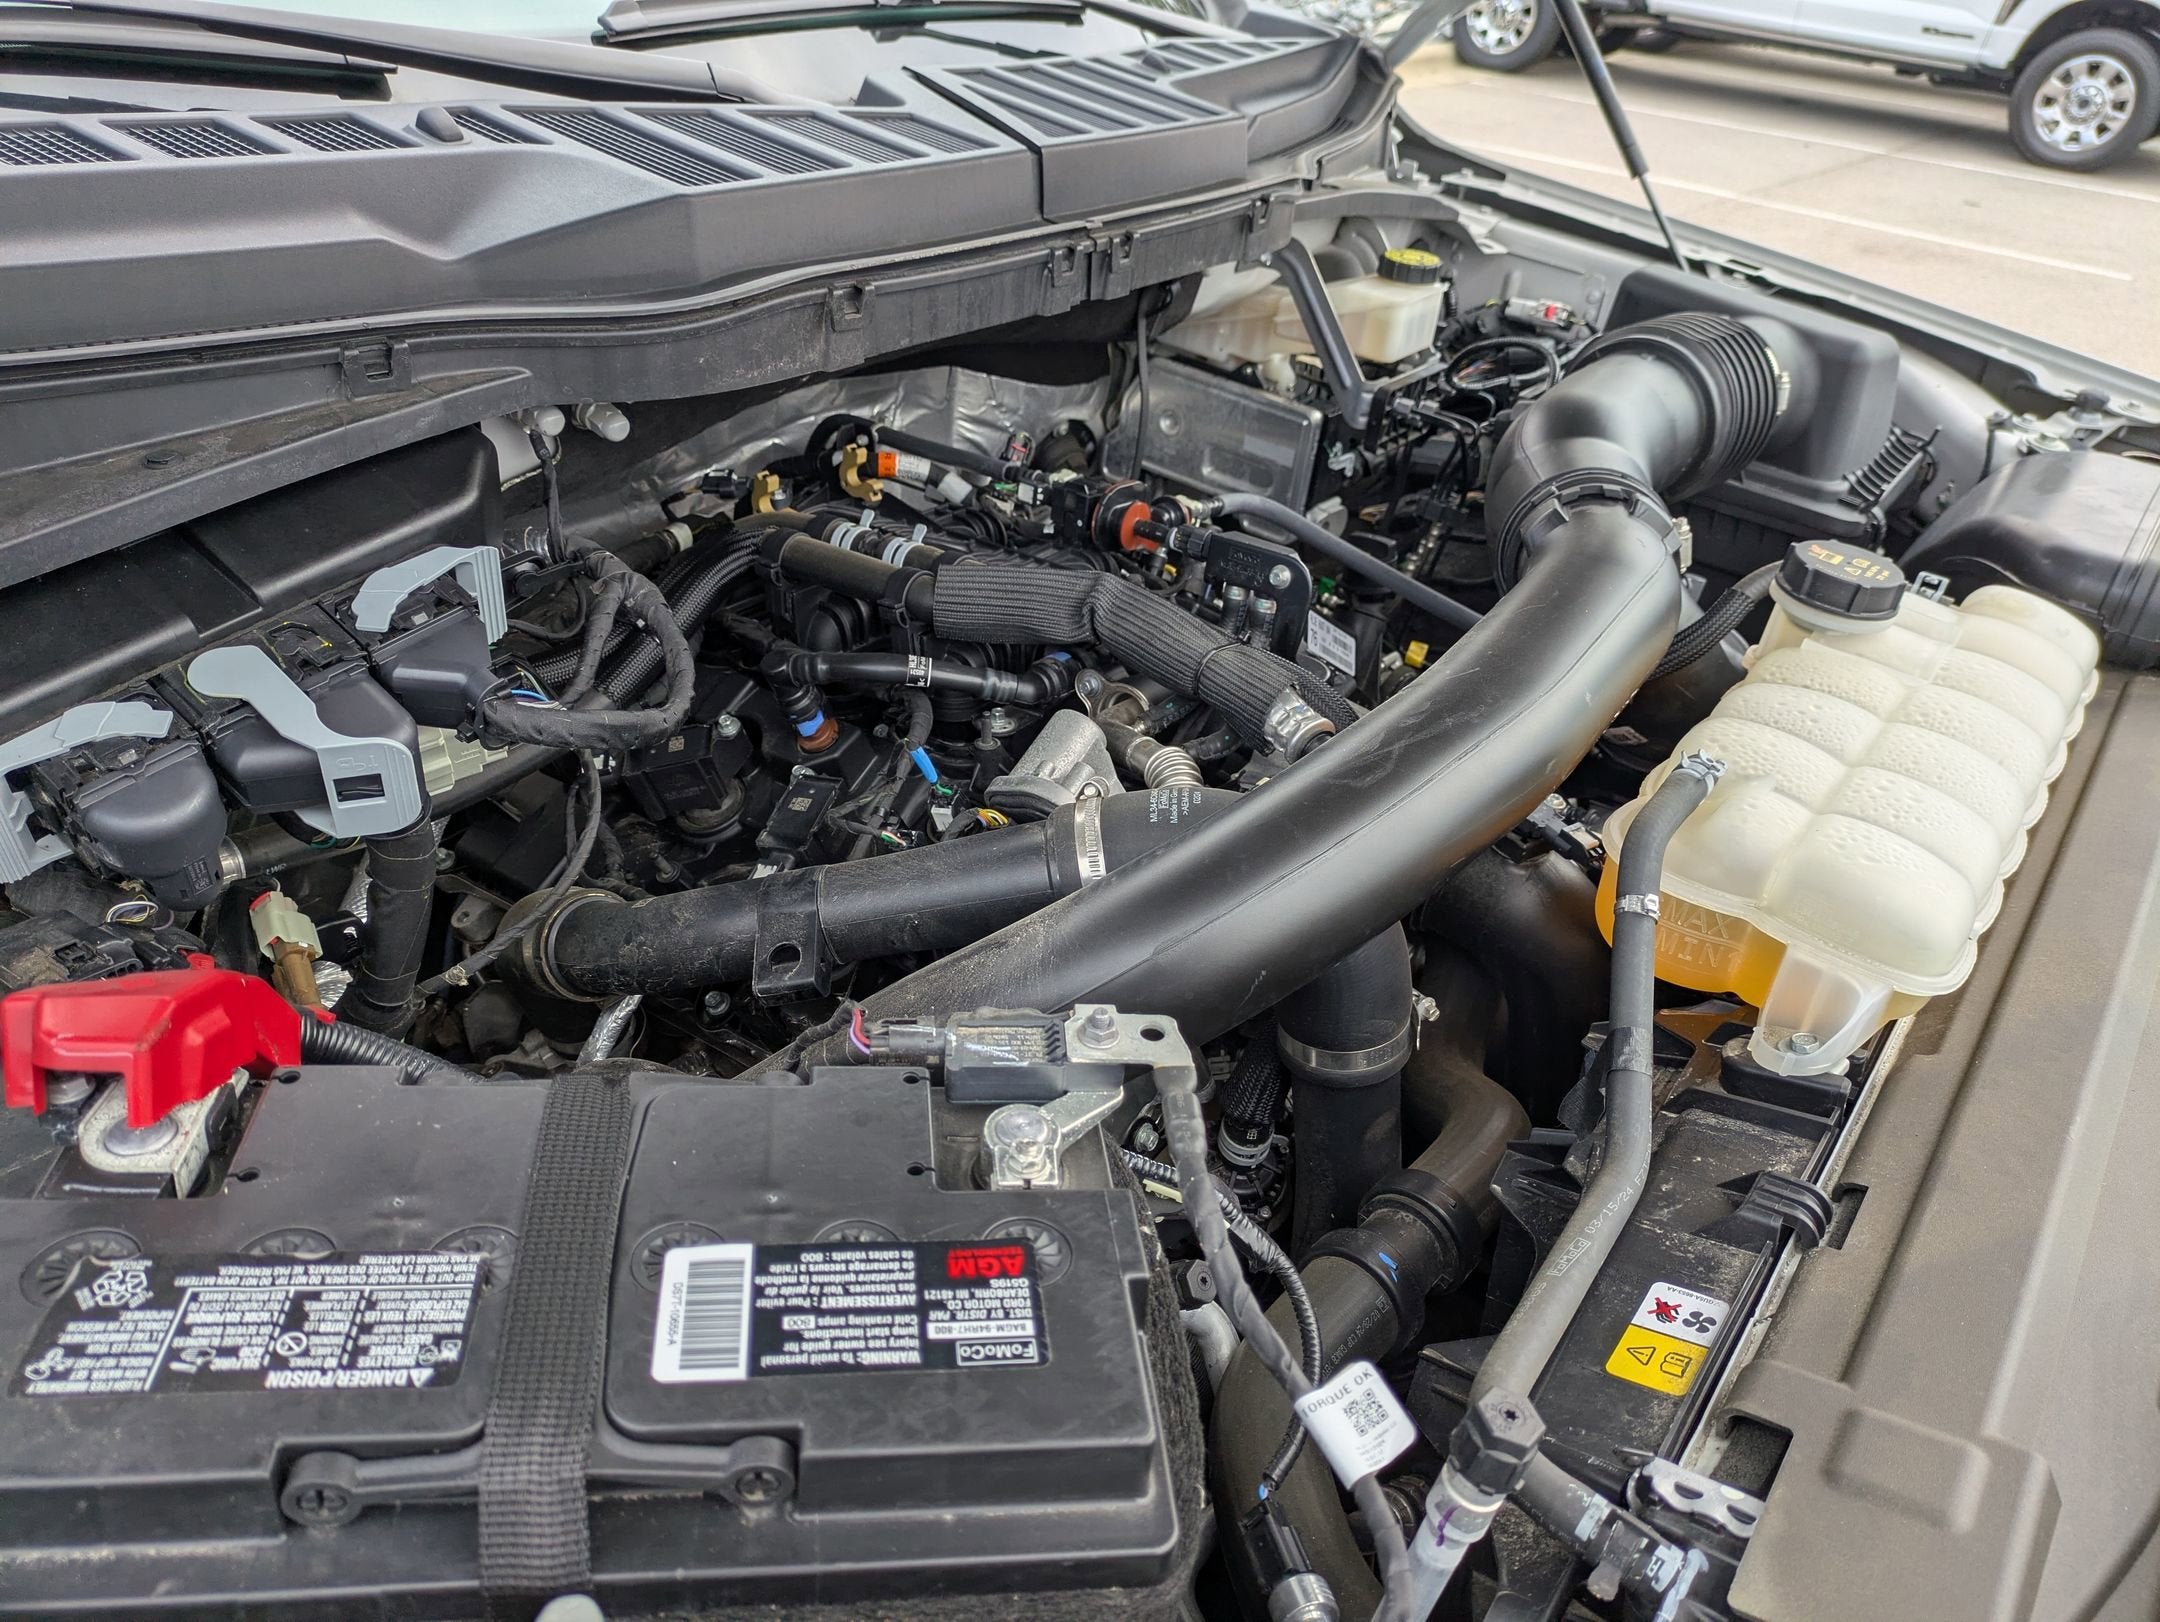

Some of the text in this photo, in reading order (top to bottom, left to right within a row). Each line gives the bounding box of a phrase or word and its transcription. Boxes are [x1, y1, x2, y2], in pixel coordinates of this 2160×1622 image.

[1663, 898, 1733, 939] MAX
[1655, 926, 1725, 968] MIN
[1584, 1186, 1635, 1235] 03/15/24
[799, 1251, 825, 1263] 800
[830, 1250, 868, 1262] volants
[866, 1249, 901, 1261] cables
[900, 1249, 915, 1260] de
[273, 1266, 292, 1276] PAS
[401, 1264, 414, 1274] LA
[414, 1264, 427, 1274] DE
[427, 1263, 452, 1273] HORS
[453, 1262, 477, 1273] TENIR
[807, 1262, 847, 1273] secours
[900, 1260, 915, 1270] de
[947, 1256, 1025, 1279] AGM
[217, 1276, 240, 1287] OPEN
[240, 1276, 259, 1287] NOT
[406, 1273, 423, 1284] THE
[423, 1273, 436, 1283] OF
[435, 1272, 454, 1283] OUT
[453, 1272, 475, 1283] KEEP
[798, 1273, 810, 1286] la
[763, 1285, 779, 1298] du
[778, 1283, 809, 1298] guide
[809, 1284, 821, 1297] le
[821, 1284, 845, 1296] Voir
[897, 1282, 917, 1293] des
[785, 1296, 812, 1309] Pour
[819, 1293, 917, 1309] AVERTISSEMENT
[962, 1298, 1002, 1310] MOTOR
[1002, 1297, 1031, 1309] FORD
[928, 1308, 1033, 1321] DIST. BY DISTR. PAR
[786, 1313, 918, 1329] Cold cranking amps 800
[865, 1326, 891, 1339] start
[891, 1324, 920, 1338] jump
[782, 1336, 920, 1354] injury see owner guide for
[959, 1343, 1034, 1360] FoMoCo
[760, 1349, 921, 1369] WARNING: To avoid personal
[264, 1368, 408, 1389] DANGER/POISON
[1301, 1368, 1374, 1419] TORQUE OK
